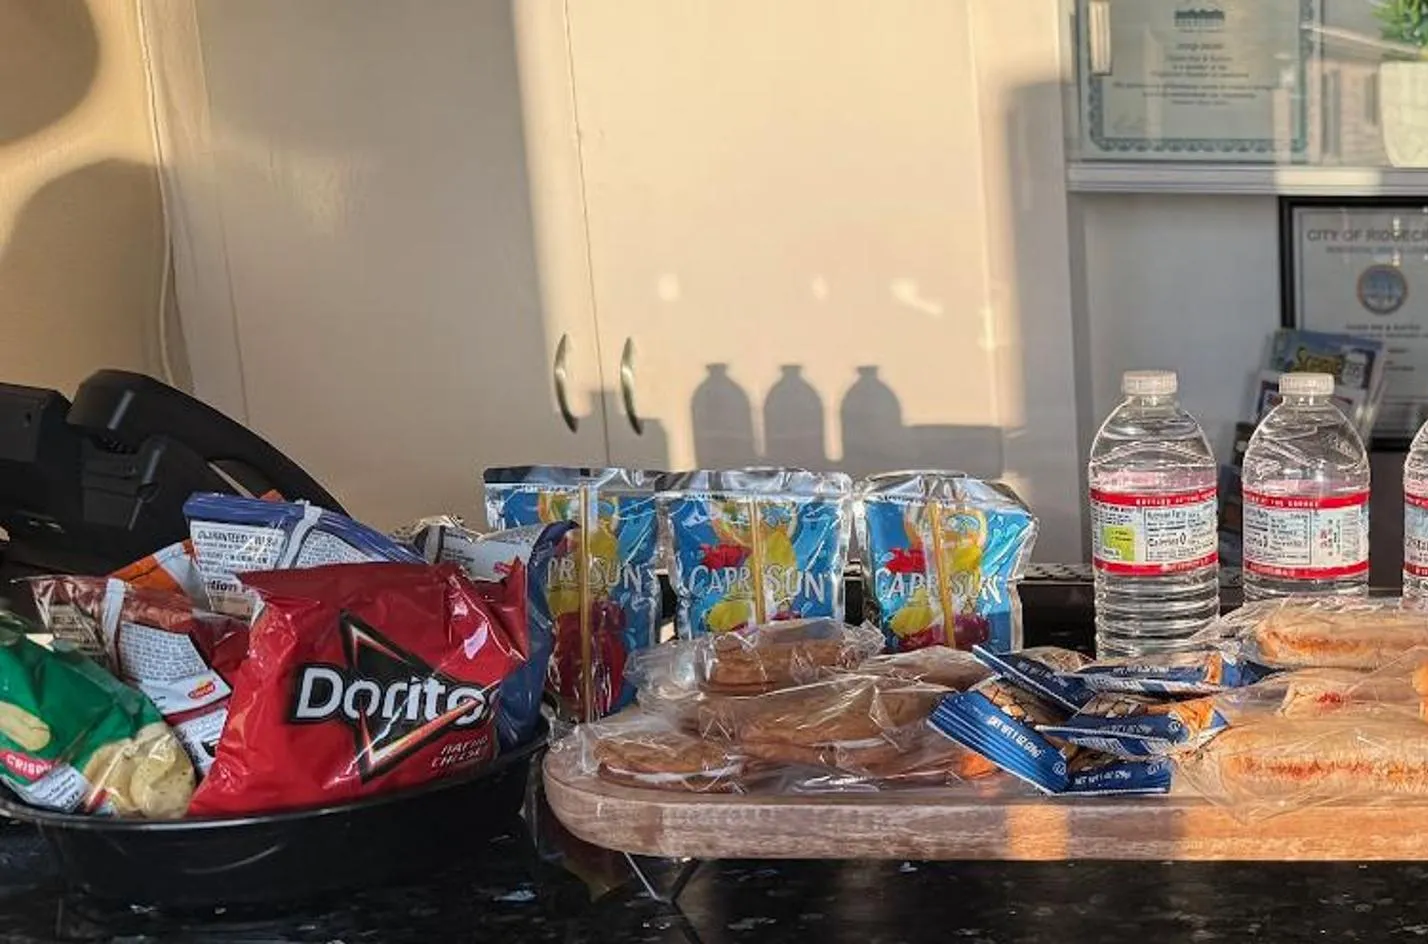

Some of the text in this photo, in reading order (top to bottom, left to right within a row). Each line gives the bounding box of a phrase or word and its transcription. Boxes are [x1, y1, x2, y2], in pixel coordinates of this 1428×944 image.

[1306, 228, 1339, 242] CITY
[689, 564, 754, 595] CAPR
[875, 567, 940, 599] CAPR
[296, 666, 499, 725] Dorito
